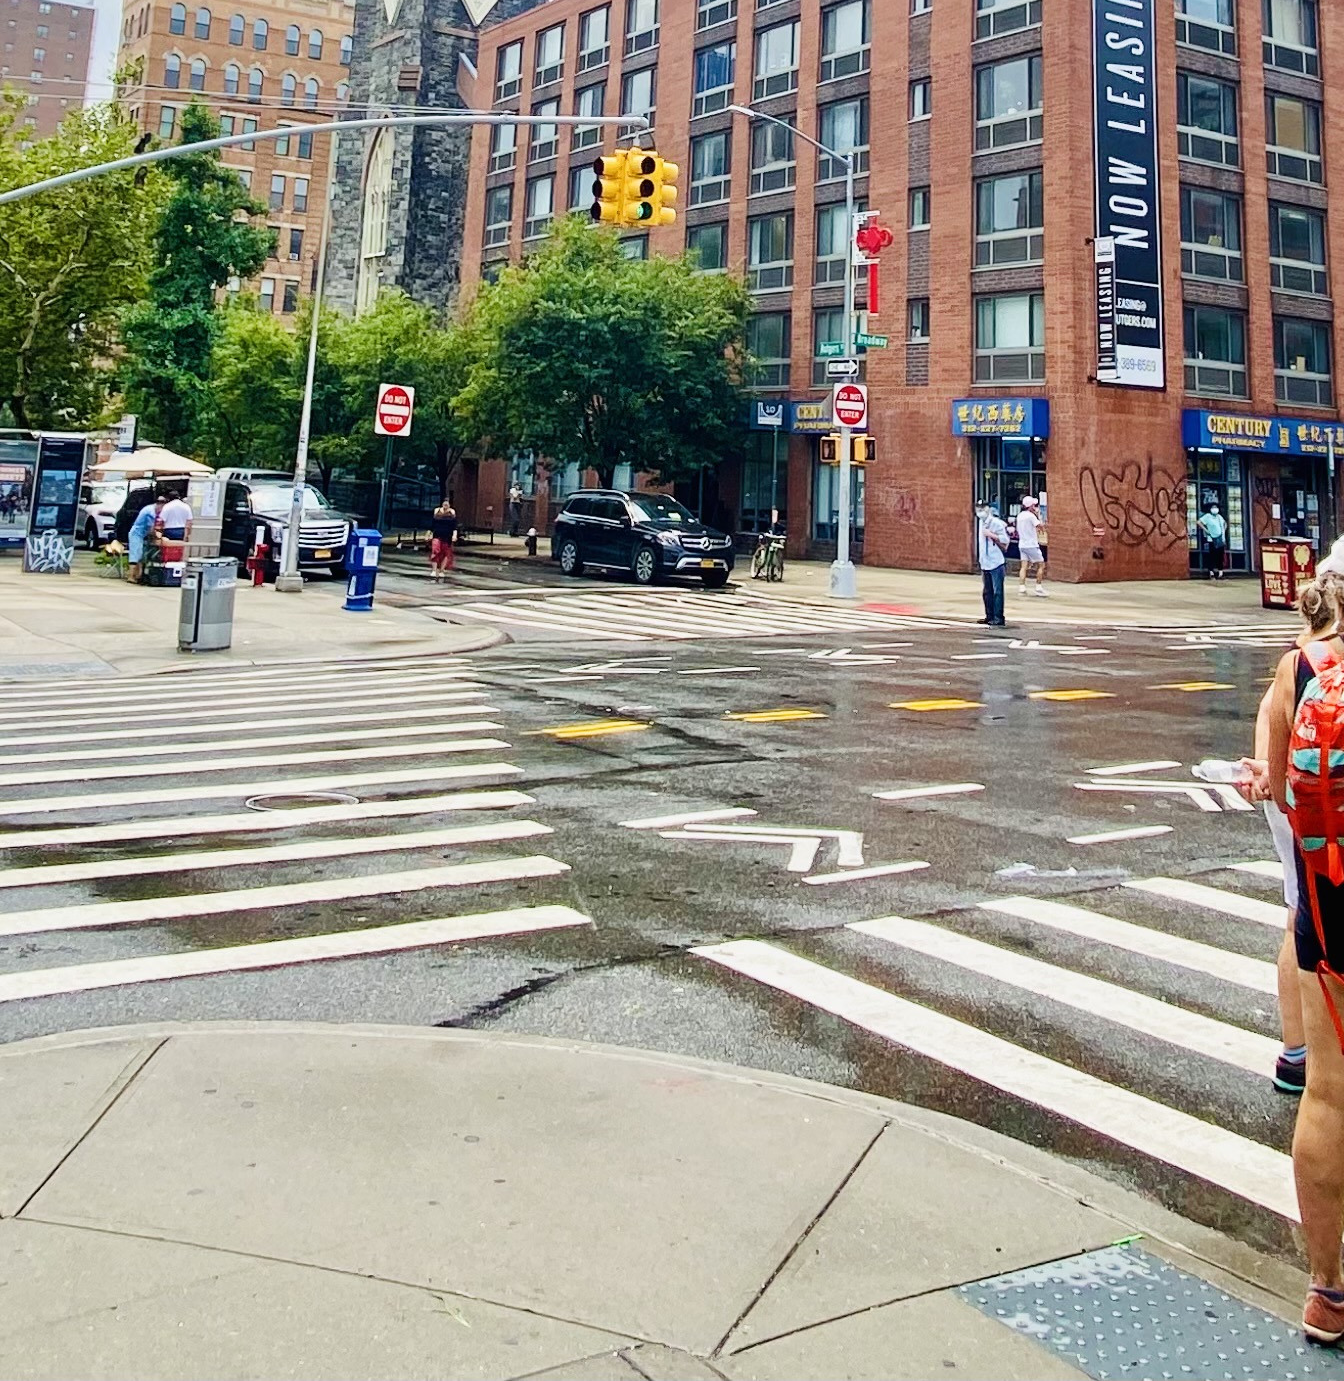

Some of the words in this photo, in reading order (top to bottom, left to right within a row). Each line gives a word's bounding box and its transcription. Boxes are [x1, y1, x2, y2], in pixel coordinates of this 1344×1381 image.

[1107, 156, 1150, 249] NOW
[1098, 267, 1113, 318] LEASING
[1116, 297, 1147, 312] EASING@
[1116, 313, 1157, 329] UTGERS.COM
[1099, 323, 1113, 349] NOW
[384, 394, 394, 403] DO
[394, 395, 407, 405] NOT
[839, 392, 849, 400] DO
[849, 393, 862, 401] NOT
[765, 404, 776, 414] 10
[797, 403, 823, 419] CENT
[840, 410, 860, 419] ENTER
[1207, 414, 1272, 437] CENTURY
